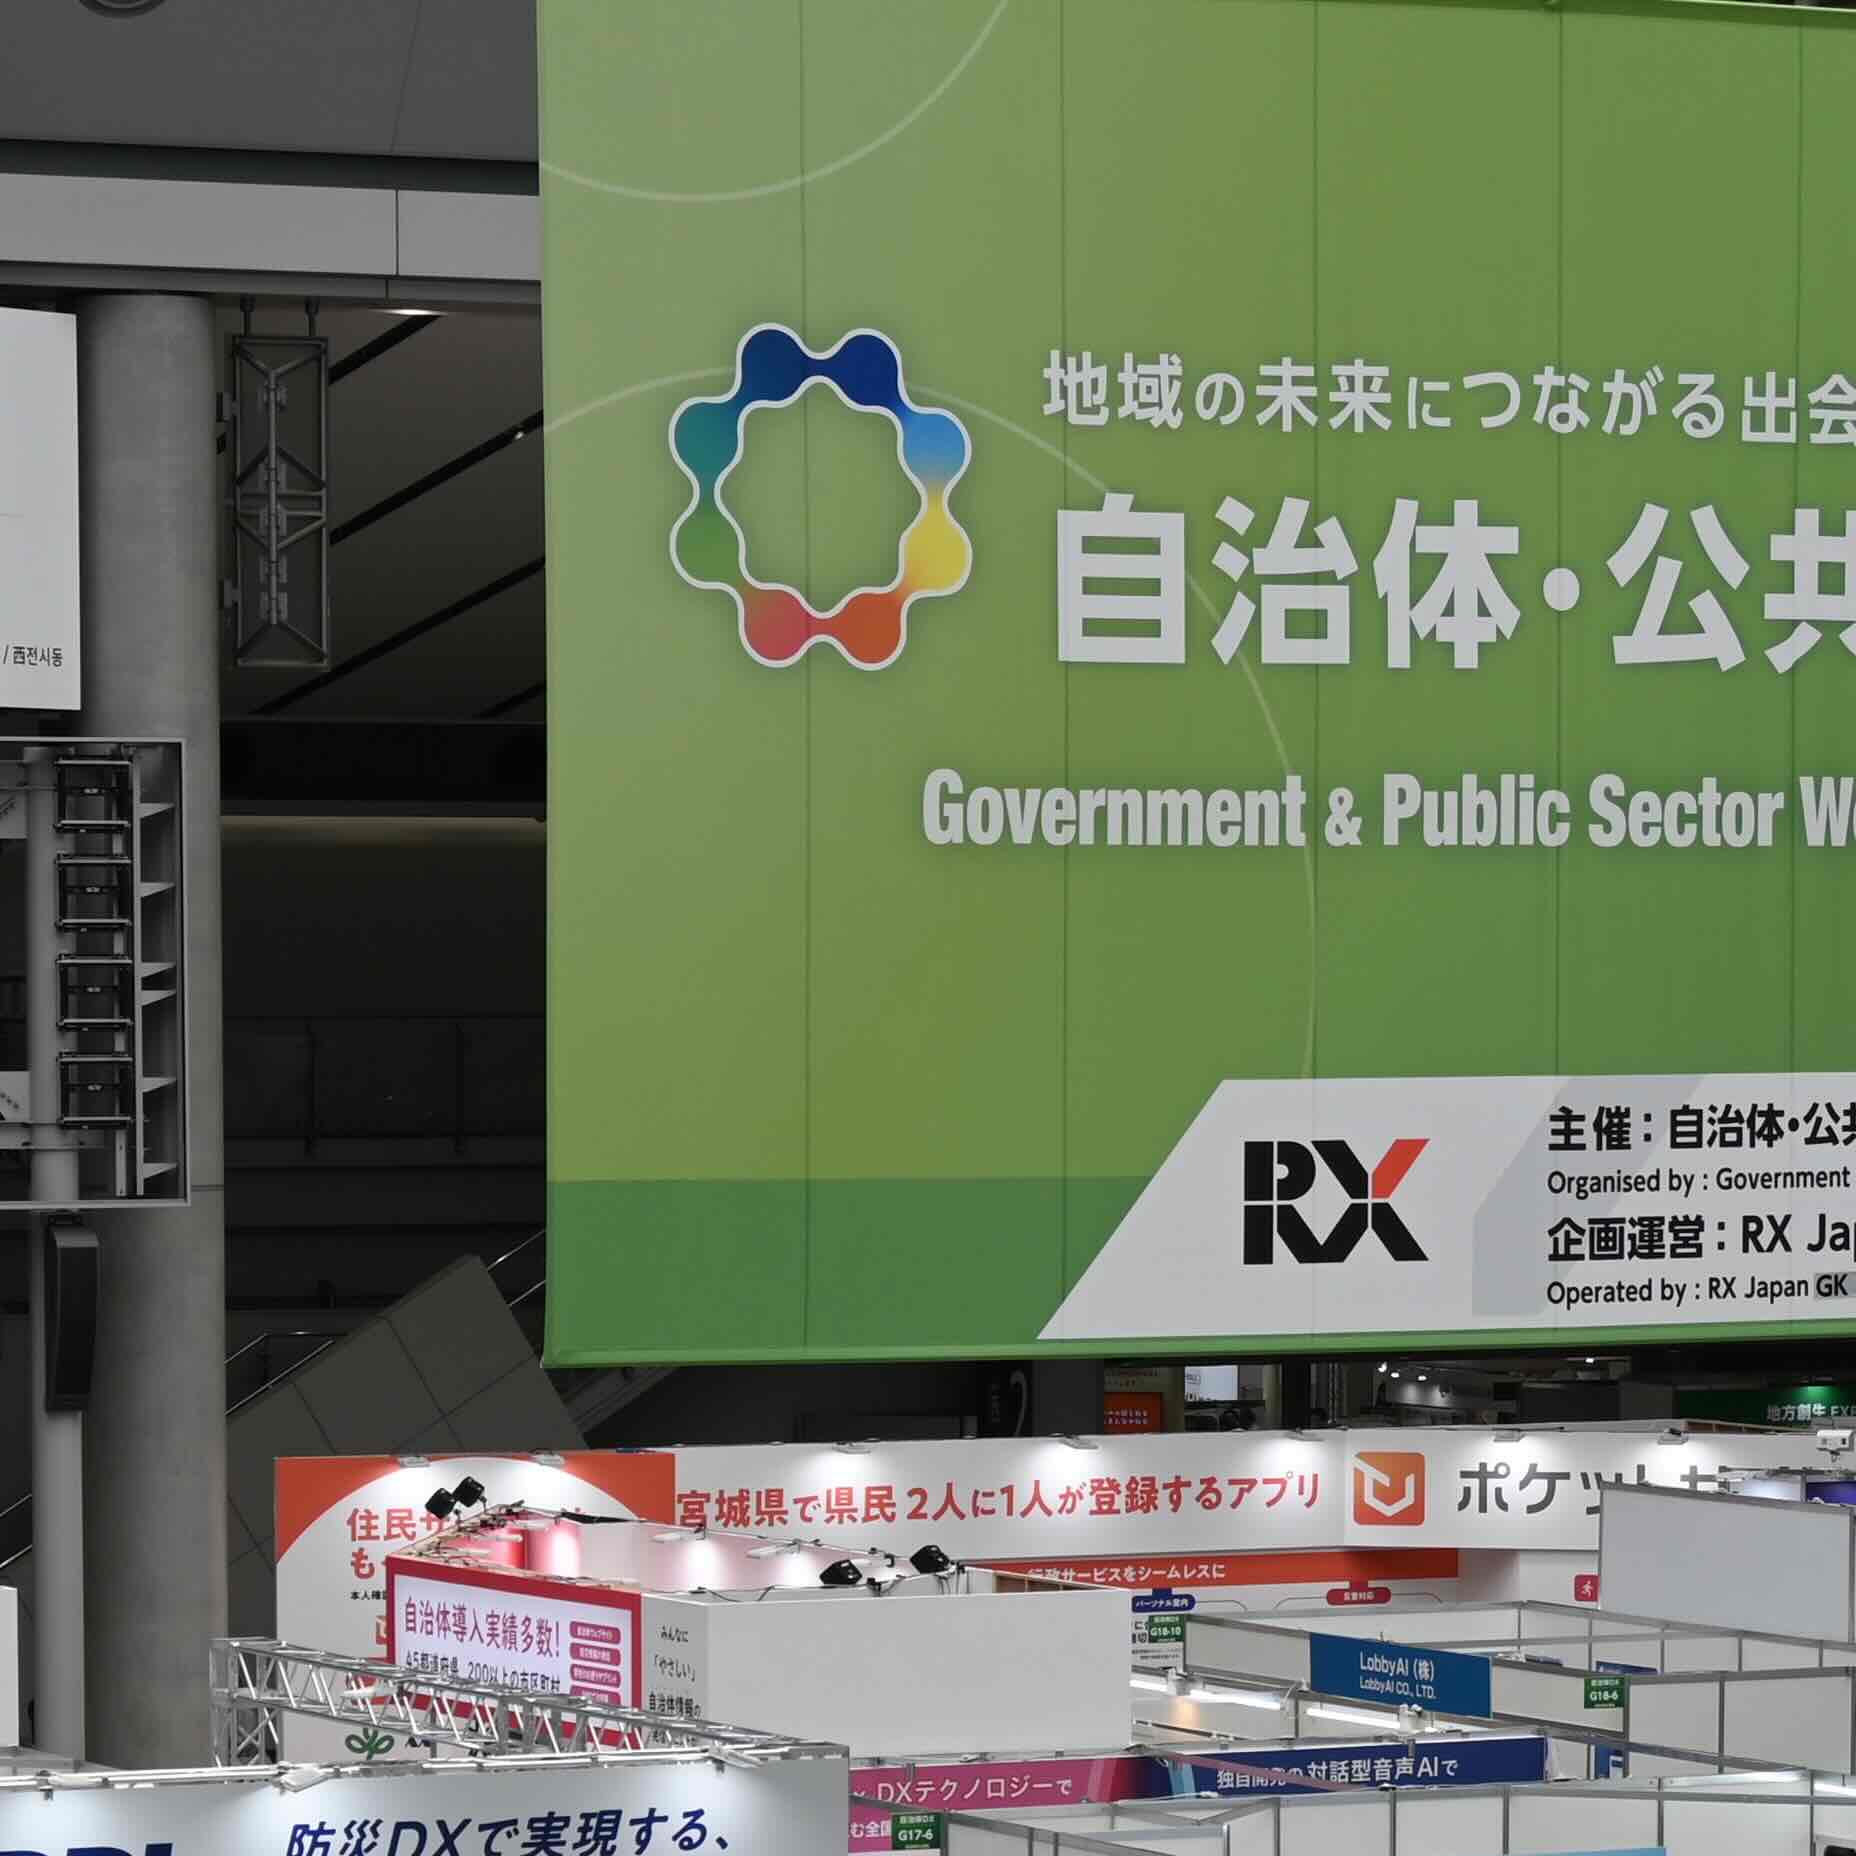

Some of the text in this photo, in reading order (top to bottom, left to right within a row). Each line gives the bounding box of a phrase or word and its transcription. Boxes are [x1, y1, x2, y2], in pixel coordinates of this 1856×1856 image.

[921, 768, 1305, 849] Government
[1324, 778, 1364, 849] &
[1383, 771, 1572, 849] Public
[1587, 774, 1783, 850] Sector
[1547, 1168, 1662, 1199] Organised
[1668, 1166, 1695, 1198] by
[1716, 1163, 1852, 1192] Government
[1242, 1138, 1430, 1267] RX
[1547, 1272, 1849, 1309] Operated by RX Japan GK
[405, 1596, 561, 1659] 自治体導入実績多数！
[1150, 1626, 1182, 1637] G18-10
[1360, 1650, 1410, 1677] LobbyAI
[1589, 1689, 1620, 1702] G18-6
[898, 1828, 934, 1842] G17-6
